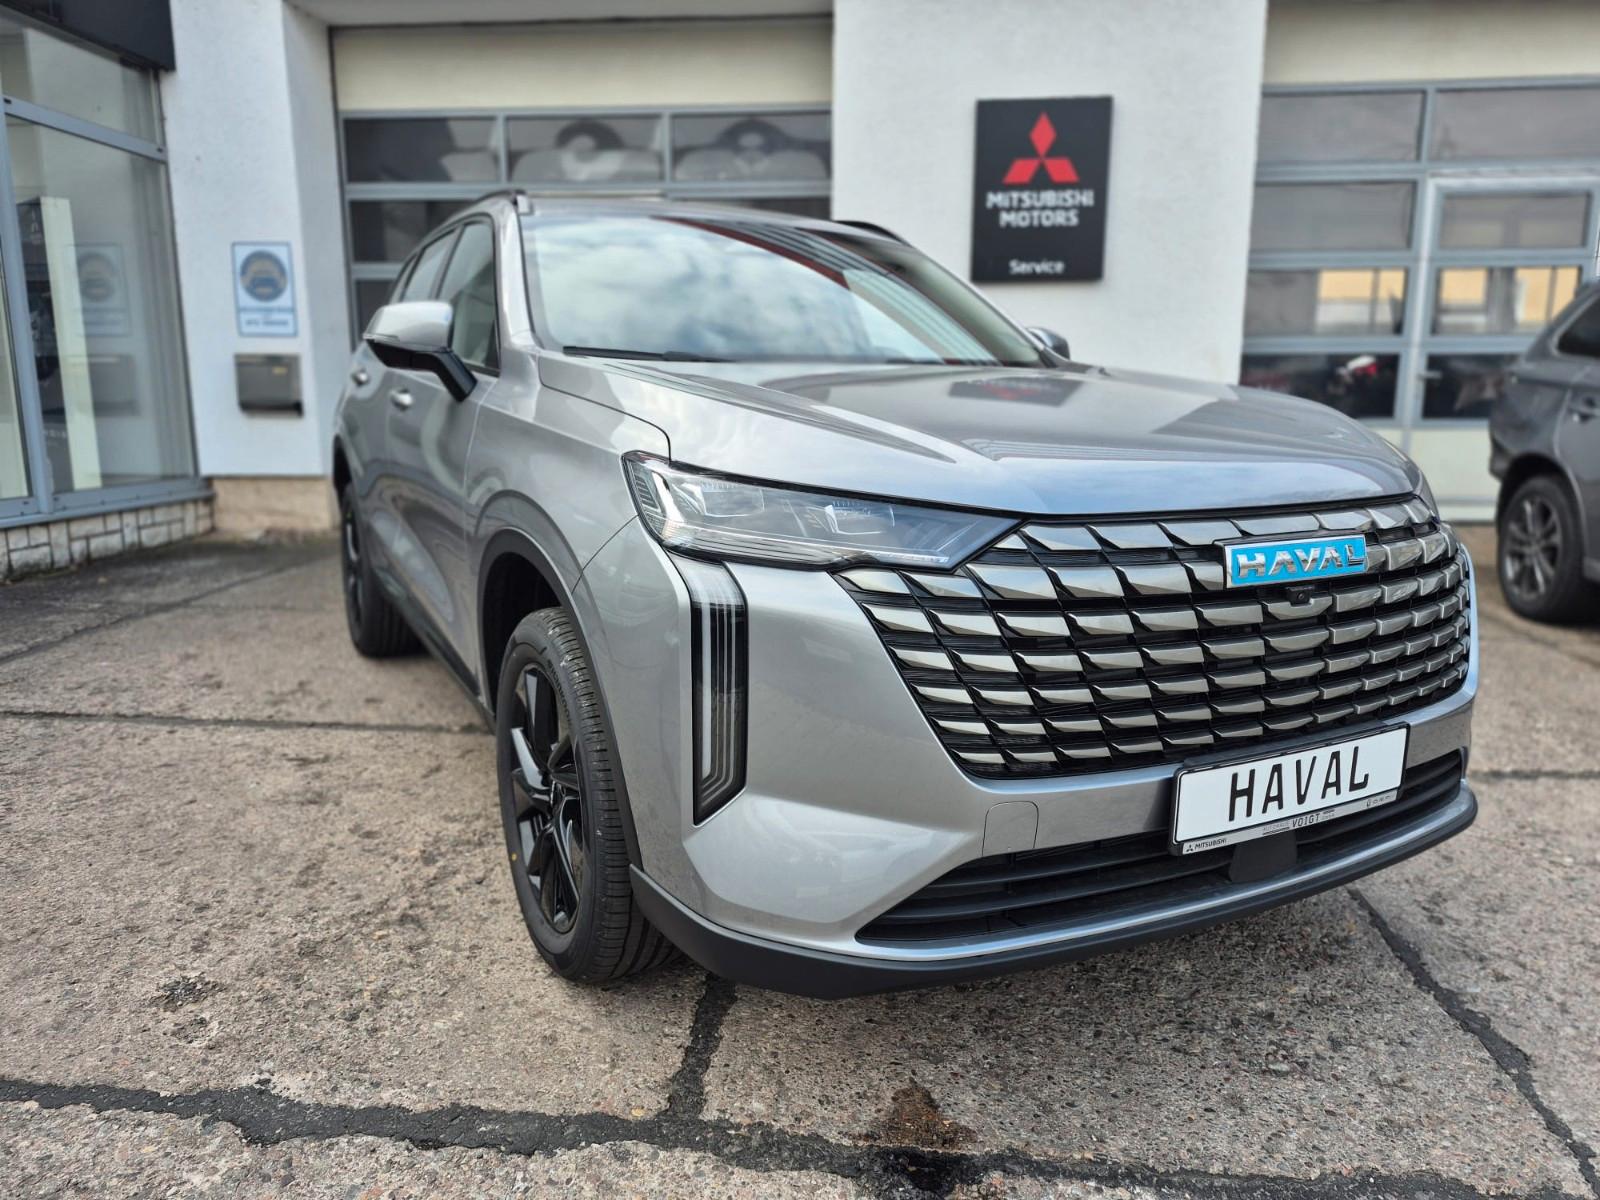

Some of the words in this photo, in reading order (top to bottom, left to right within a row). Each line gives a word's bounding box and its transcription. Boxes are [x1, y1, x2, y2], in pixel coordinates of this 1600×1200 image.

[986, 189, 1095, 208] MITSUBISHI
[999, 209, 1079, 227] MOTORS
[1009, 259, 1065, 274] Service
[1236, 543, 1365, 578] HAVAL
[1228, 746, 1369, 822] HAVAL
[1292, 813, 1321, 828] VOIGT
[1194, 838, 1227, 850] MITSUBISHI
